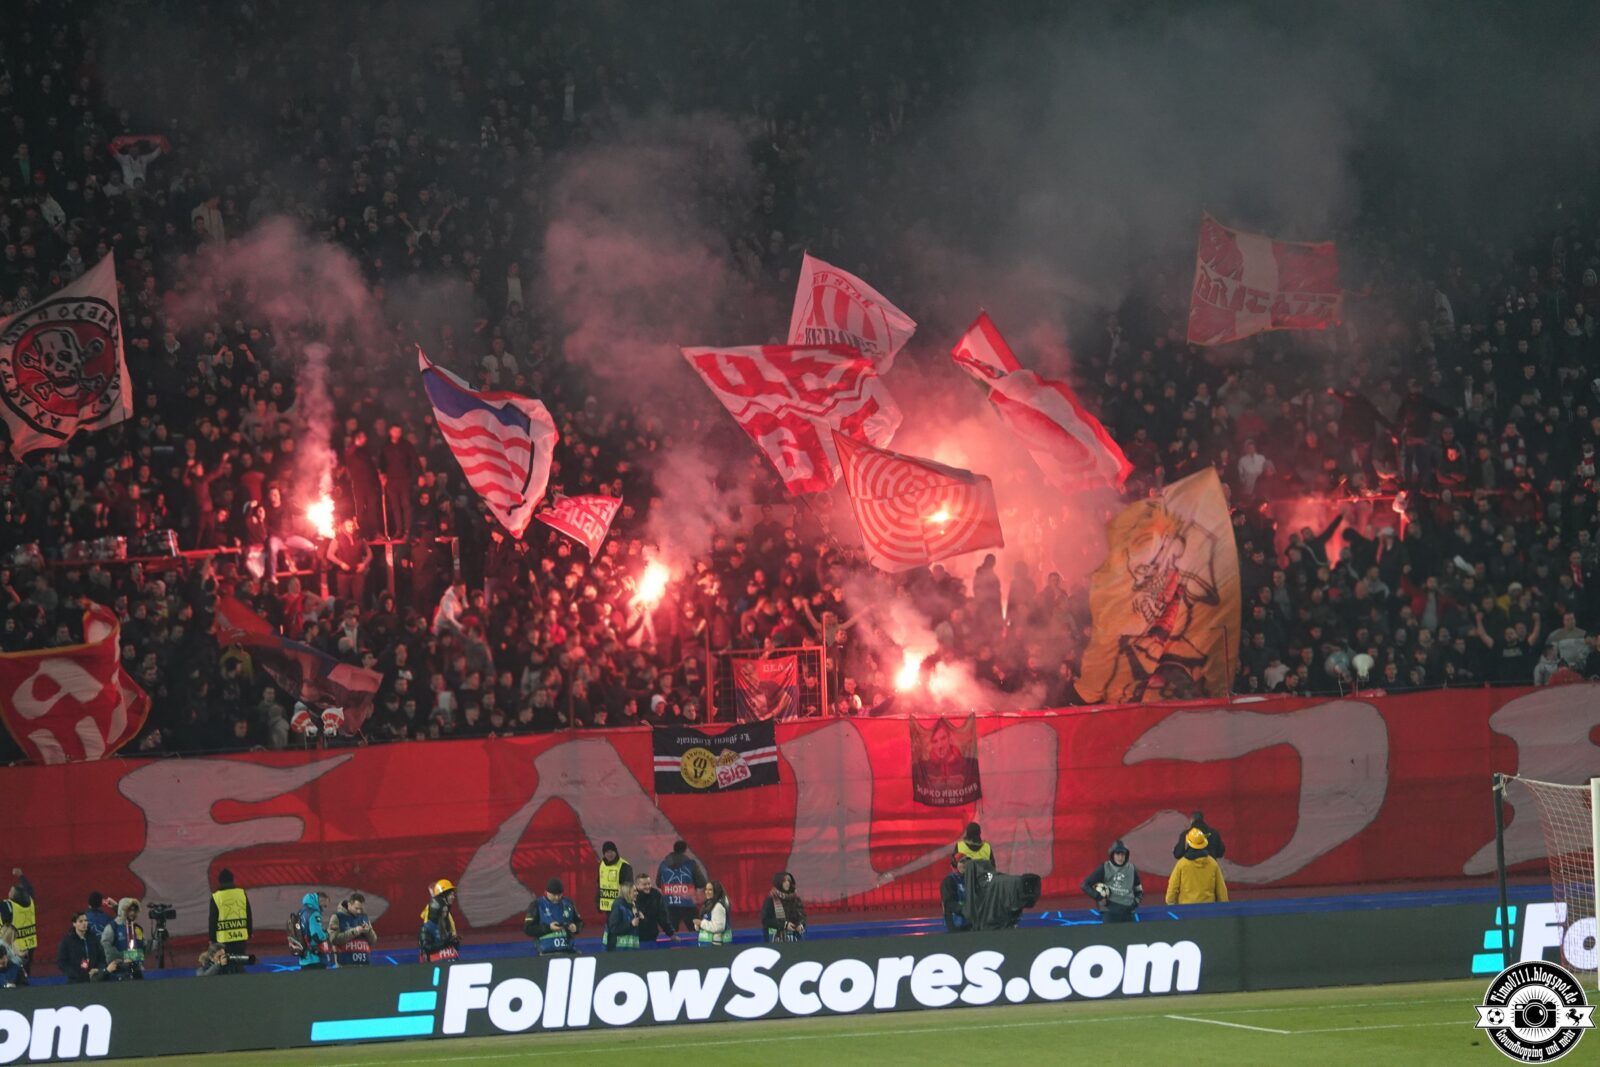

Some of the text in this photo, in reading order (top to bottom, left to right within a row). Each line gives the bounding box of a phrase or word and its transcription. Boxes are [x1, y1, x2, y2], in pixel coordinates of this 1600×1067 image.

[664, 885, 688, 894] PHOTO
[228, 931, 243, 940] 344
[553, 938, 568, 948] 02
[443, 940, 1201, 1034] FollowScores.com
